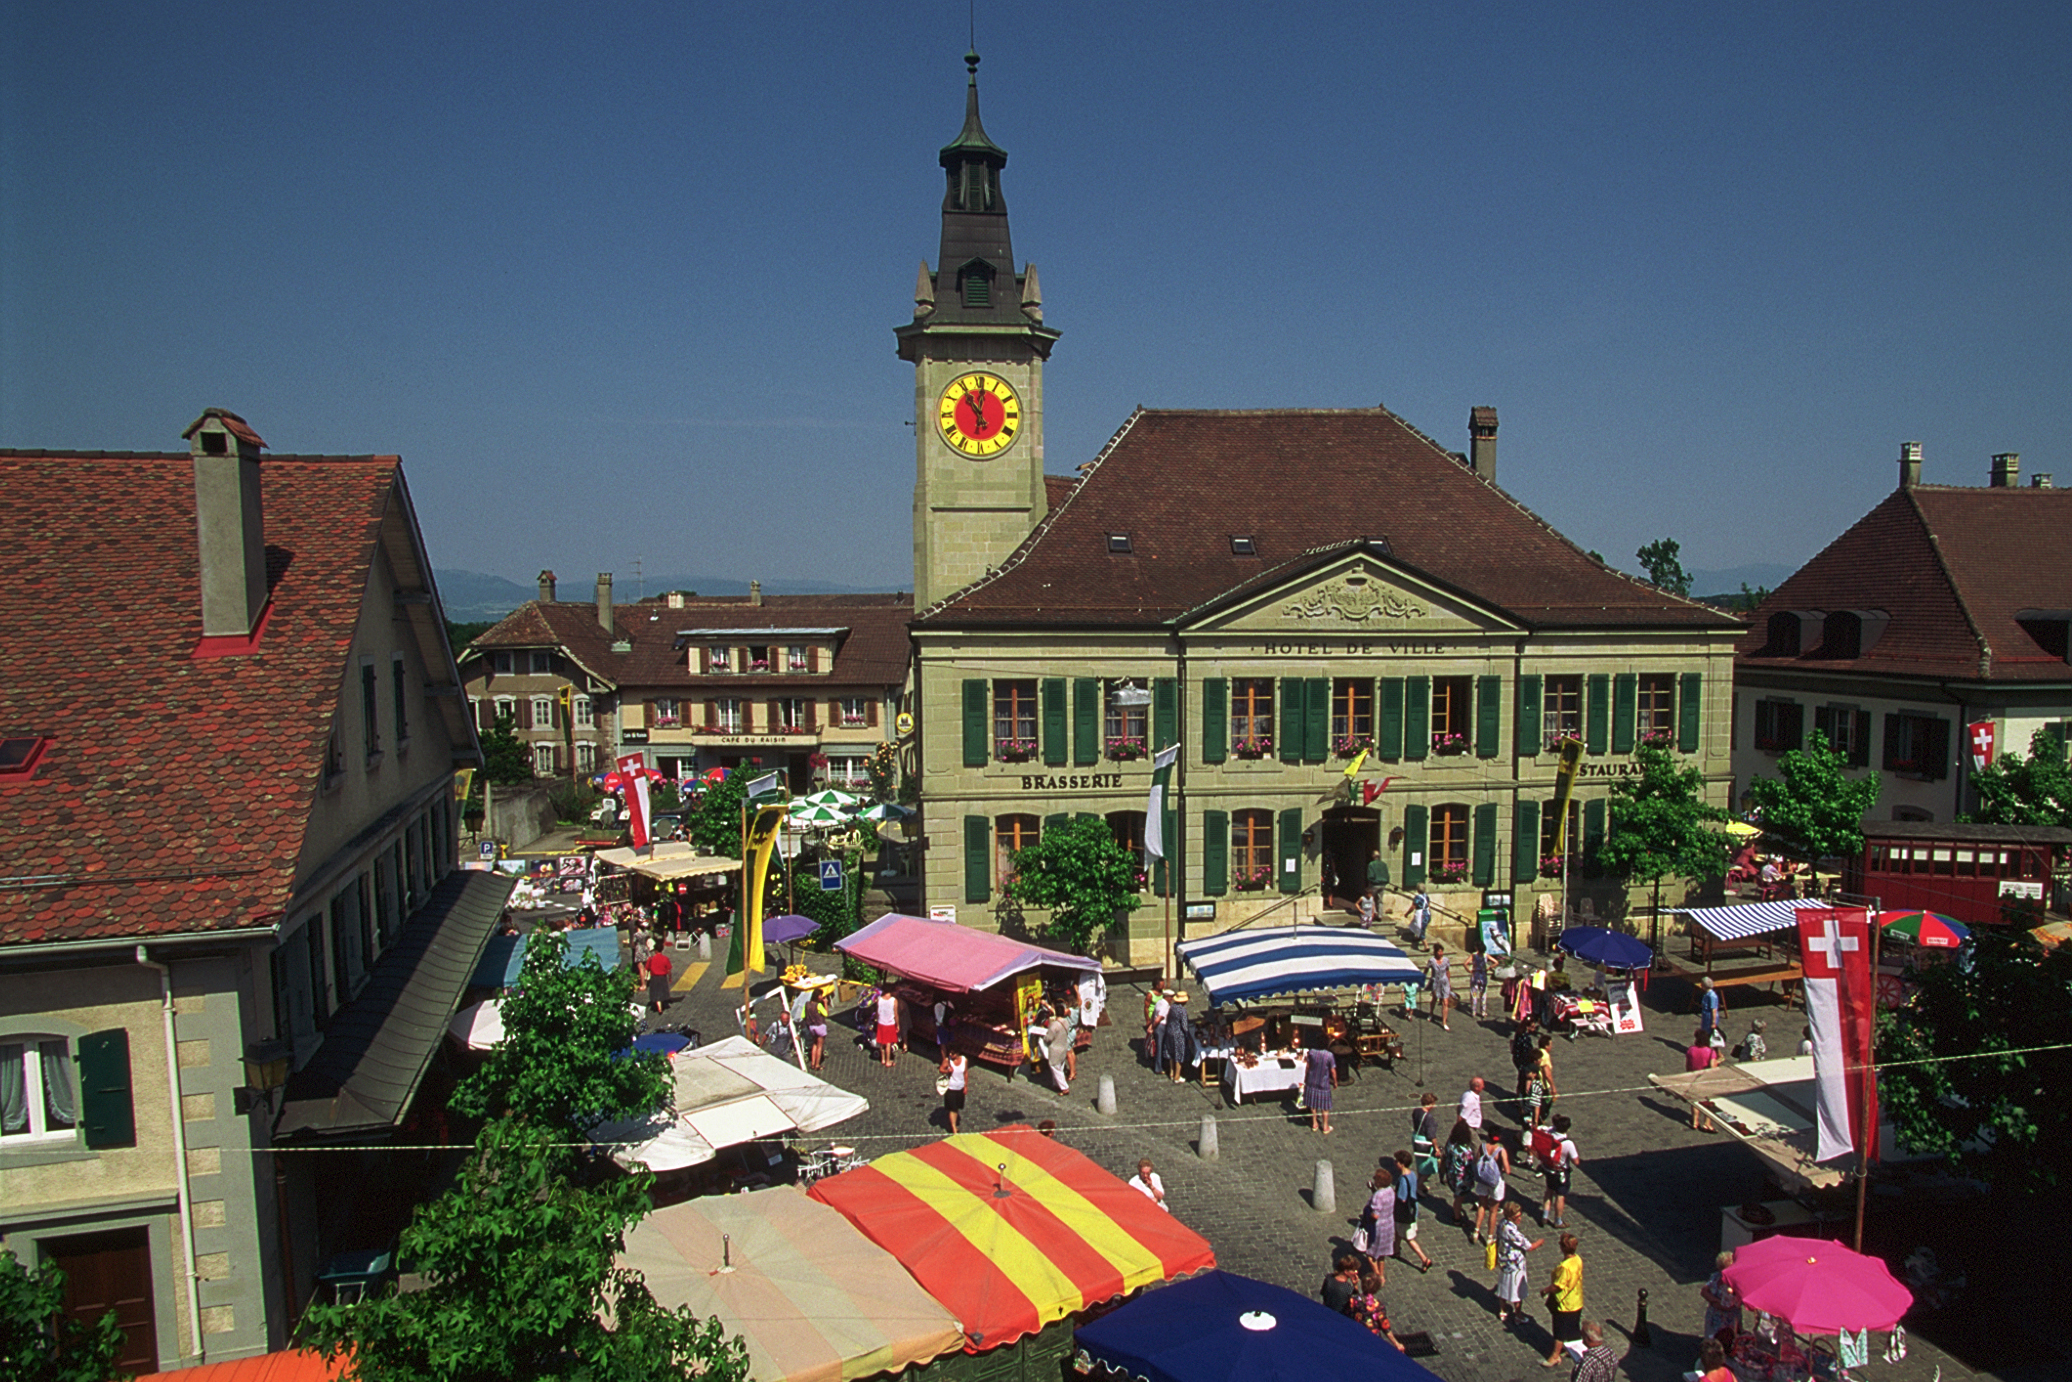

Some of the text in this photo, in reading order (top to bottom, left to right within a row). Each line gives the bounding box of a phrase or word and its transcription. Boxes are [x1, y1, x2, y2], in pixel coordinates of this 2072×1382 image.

[1264, 642, 1446, 655] HOTEL DE VILLE
[1021, 774, 1123, 790] BRASSERIE
[483, 843, 491, 853] P
